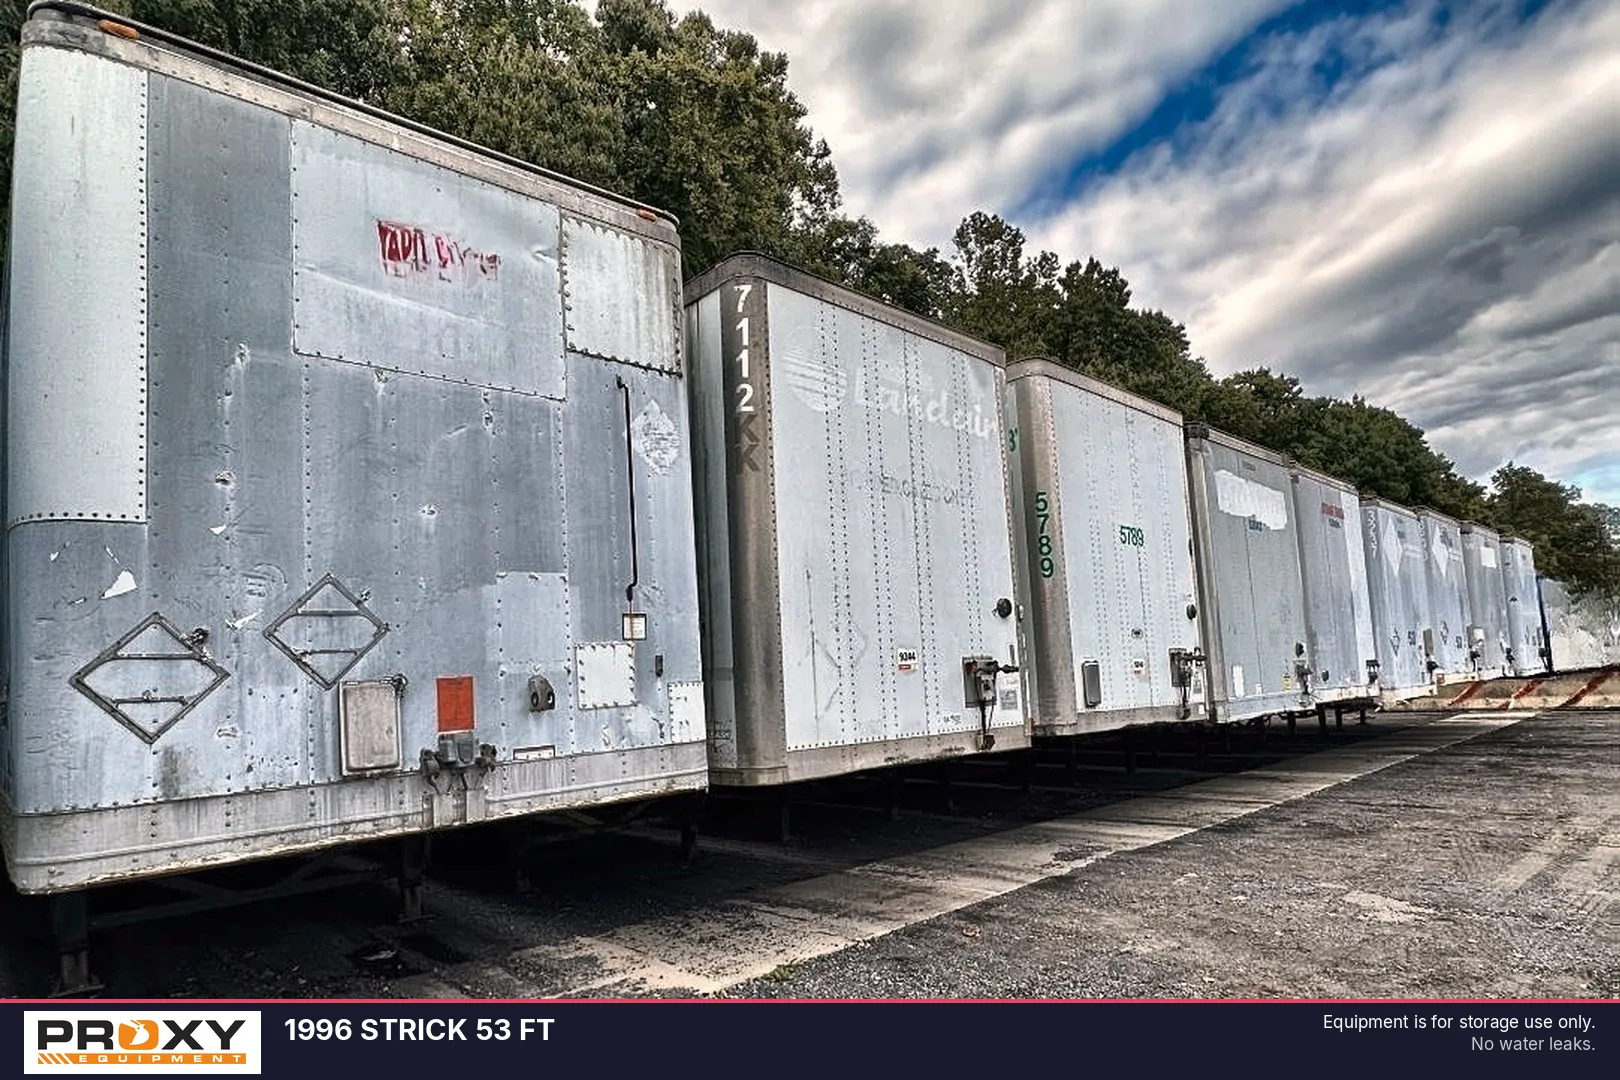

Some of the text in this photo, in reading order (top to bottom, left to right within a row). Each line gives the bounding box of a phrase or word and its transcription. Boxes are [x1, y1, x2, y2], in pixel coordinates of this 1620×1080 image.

[733, 284, 755, 412] 7112
[1035, 491, 1054, 578] 5789
[1119, 525, 1145, 547] 5789
